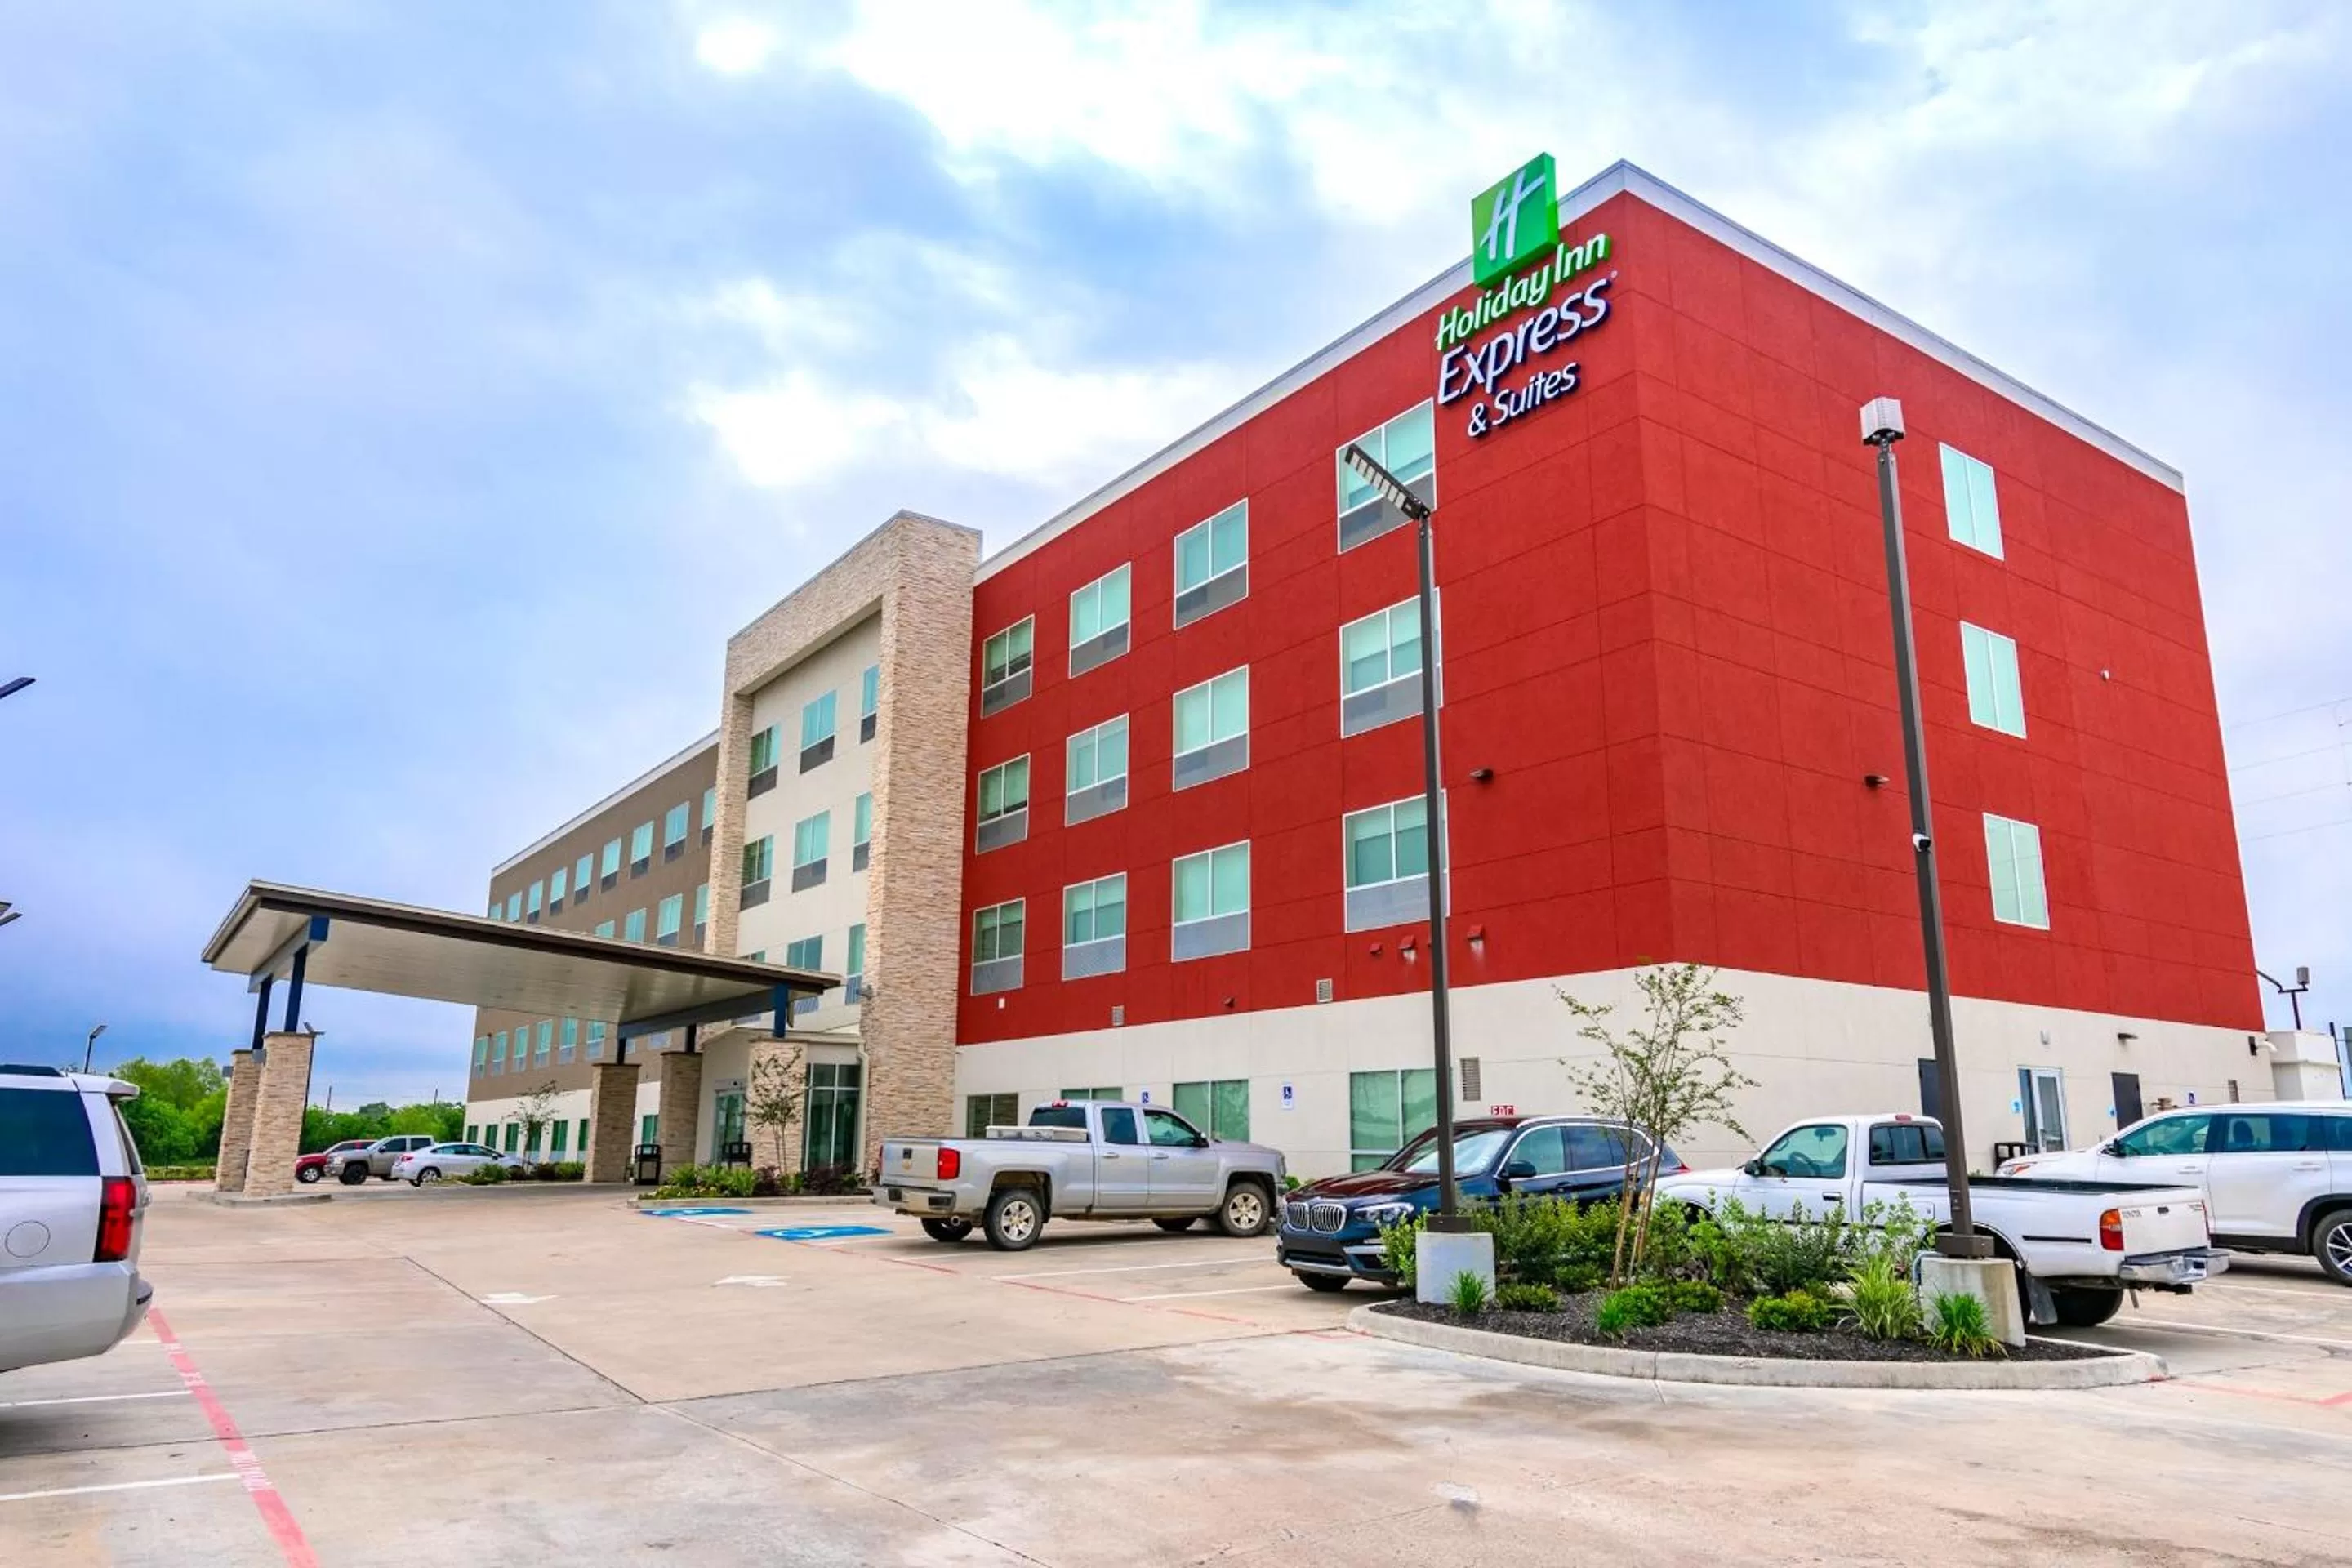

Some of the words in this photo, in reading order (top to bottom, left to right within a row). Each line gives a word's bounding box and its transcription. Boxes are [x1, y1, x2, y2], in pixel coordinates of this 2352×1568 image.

[1435, 265, 1551, 351] Holiday
[1555, 234, 1609, 283] Inn
[1437, 279, 1610, 405] Express
[1467, 403, 1488, 437] &
[1493, 362, 1580, 425] Suites
